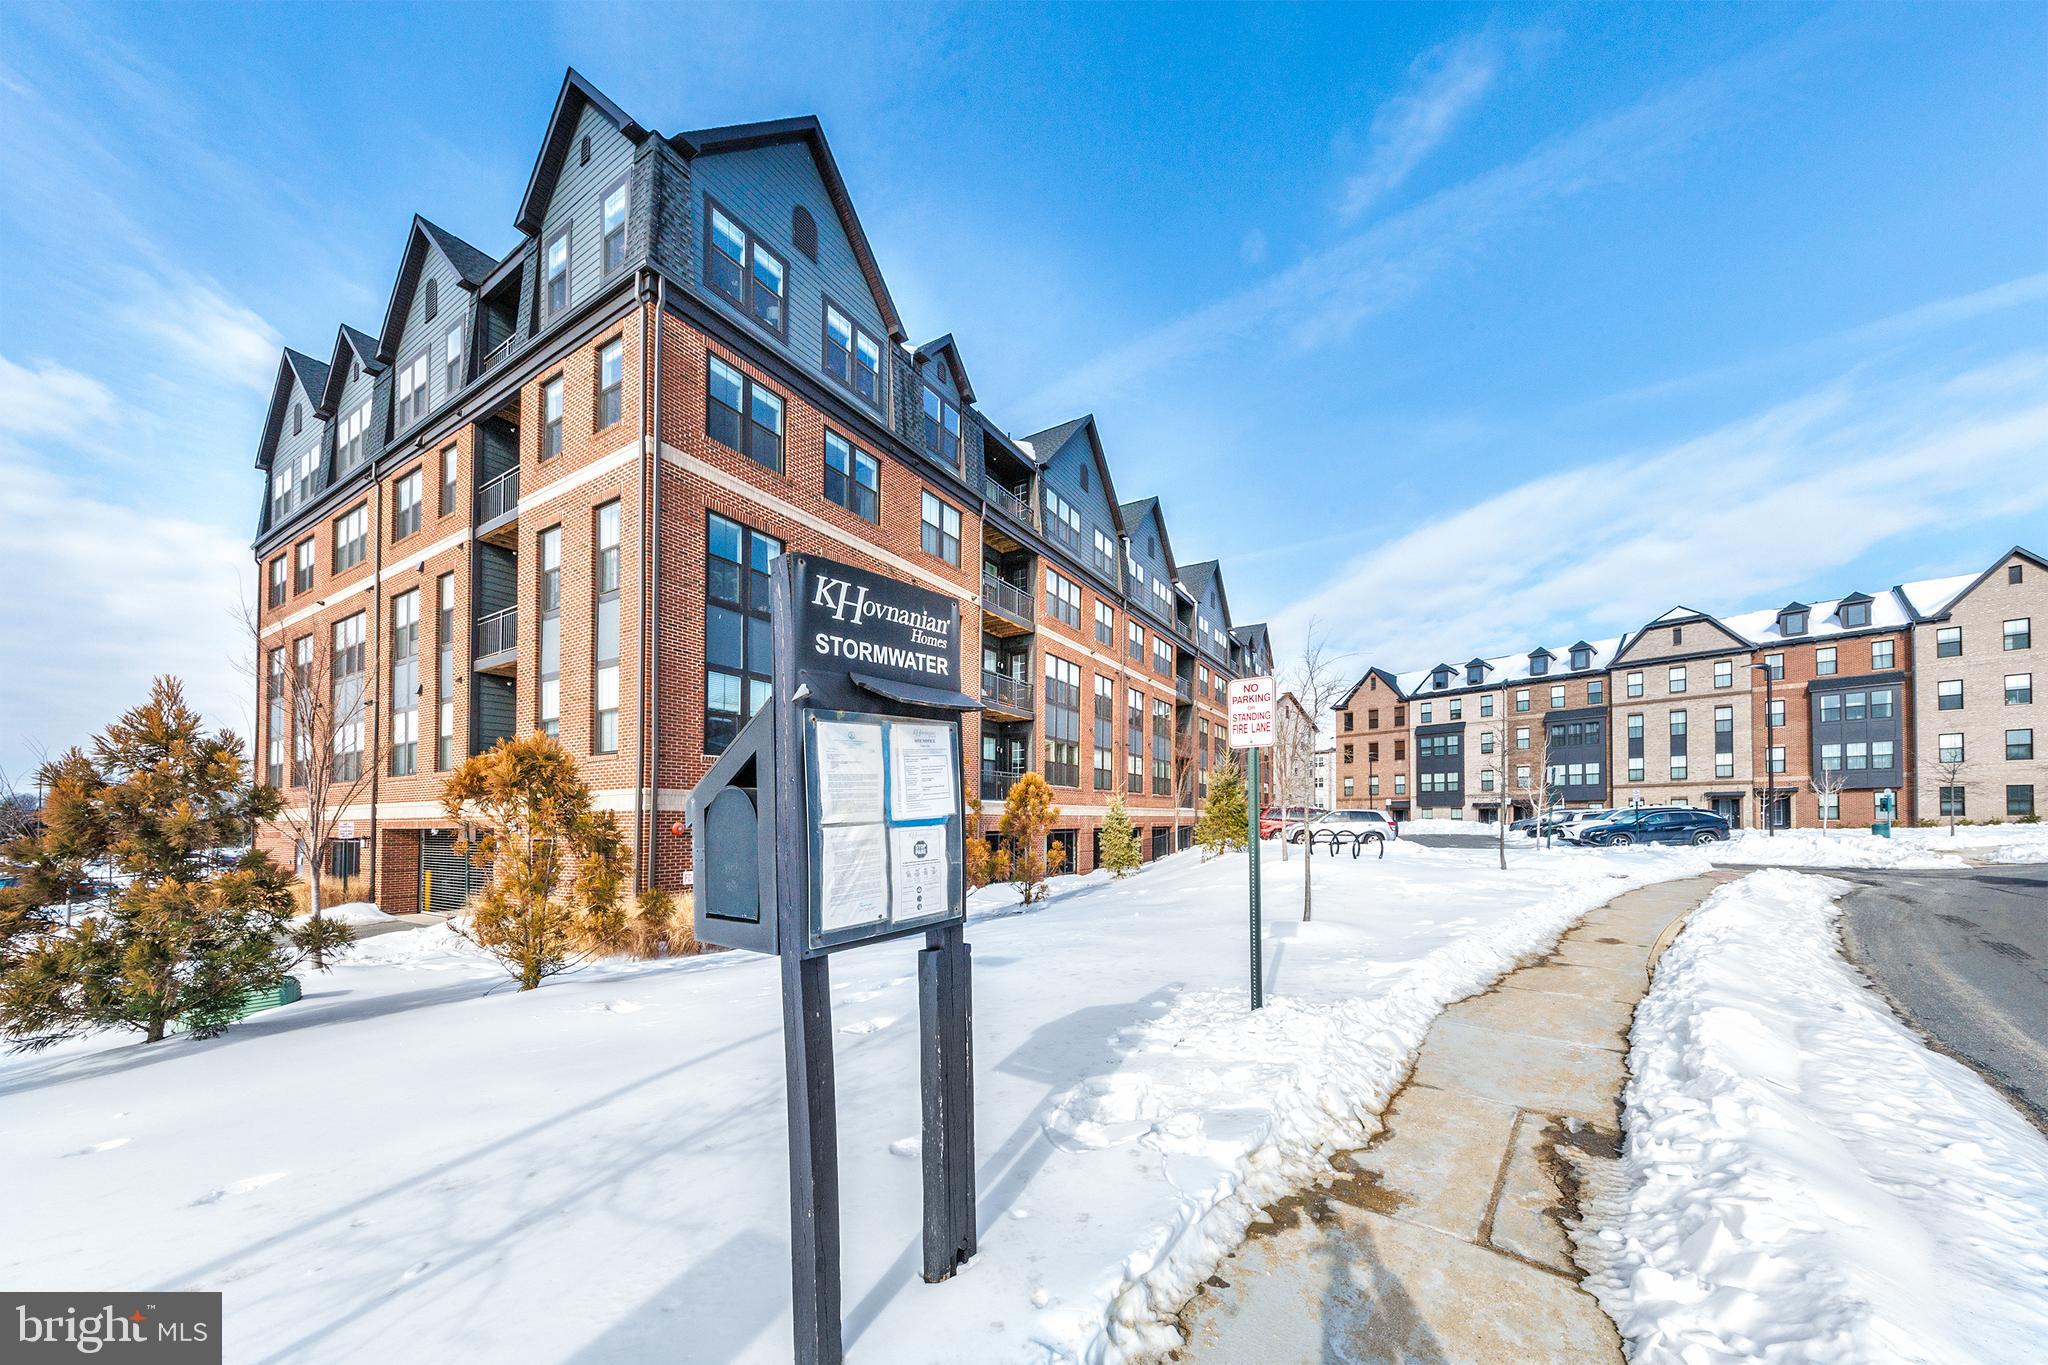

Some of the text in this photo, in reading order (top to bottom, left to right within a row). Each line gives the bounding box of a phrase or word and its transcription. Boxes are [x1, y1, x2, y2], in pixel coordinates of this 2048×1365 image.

[910, 628, 948, 649] Homes
[815, 633, 949, 676] STORMWATER
[1243, 683, 1259, 693] NO
[1232, 693, 1271, 705] PARKING
[1232, 711, 1271, 722] STANDING
[1232, 722, 1271, 734] FIRE LANE
